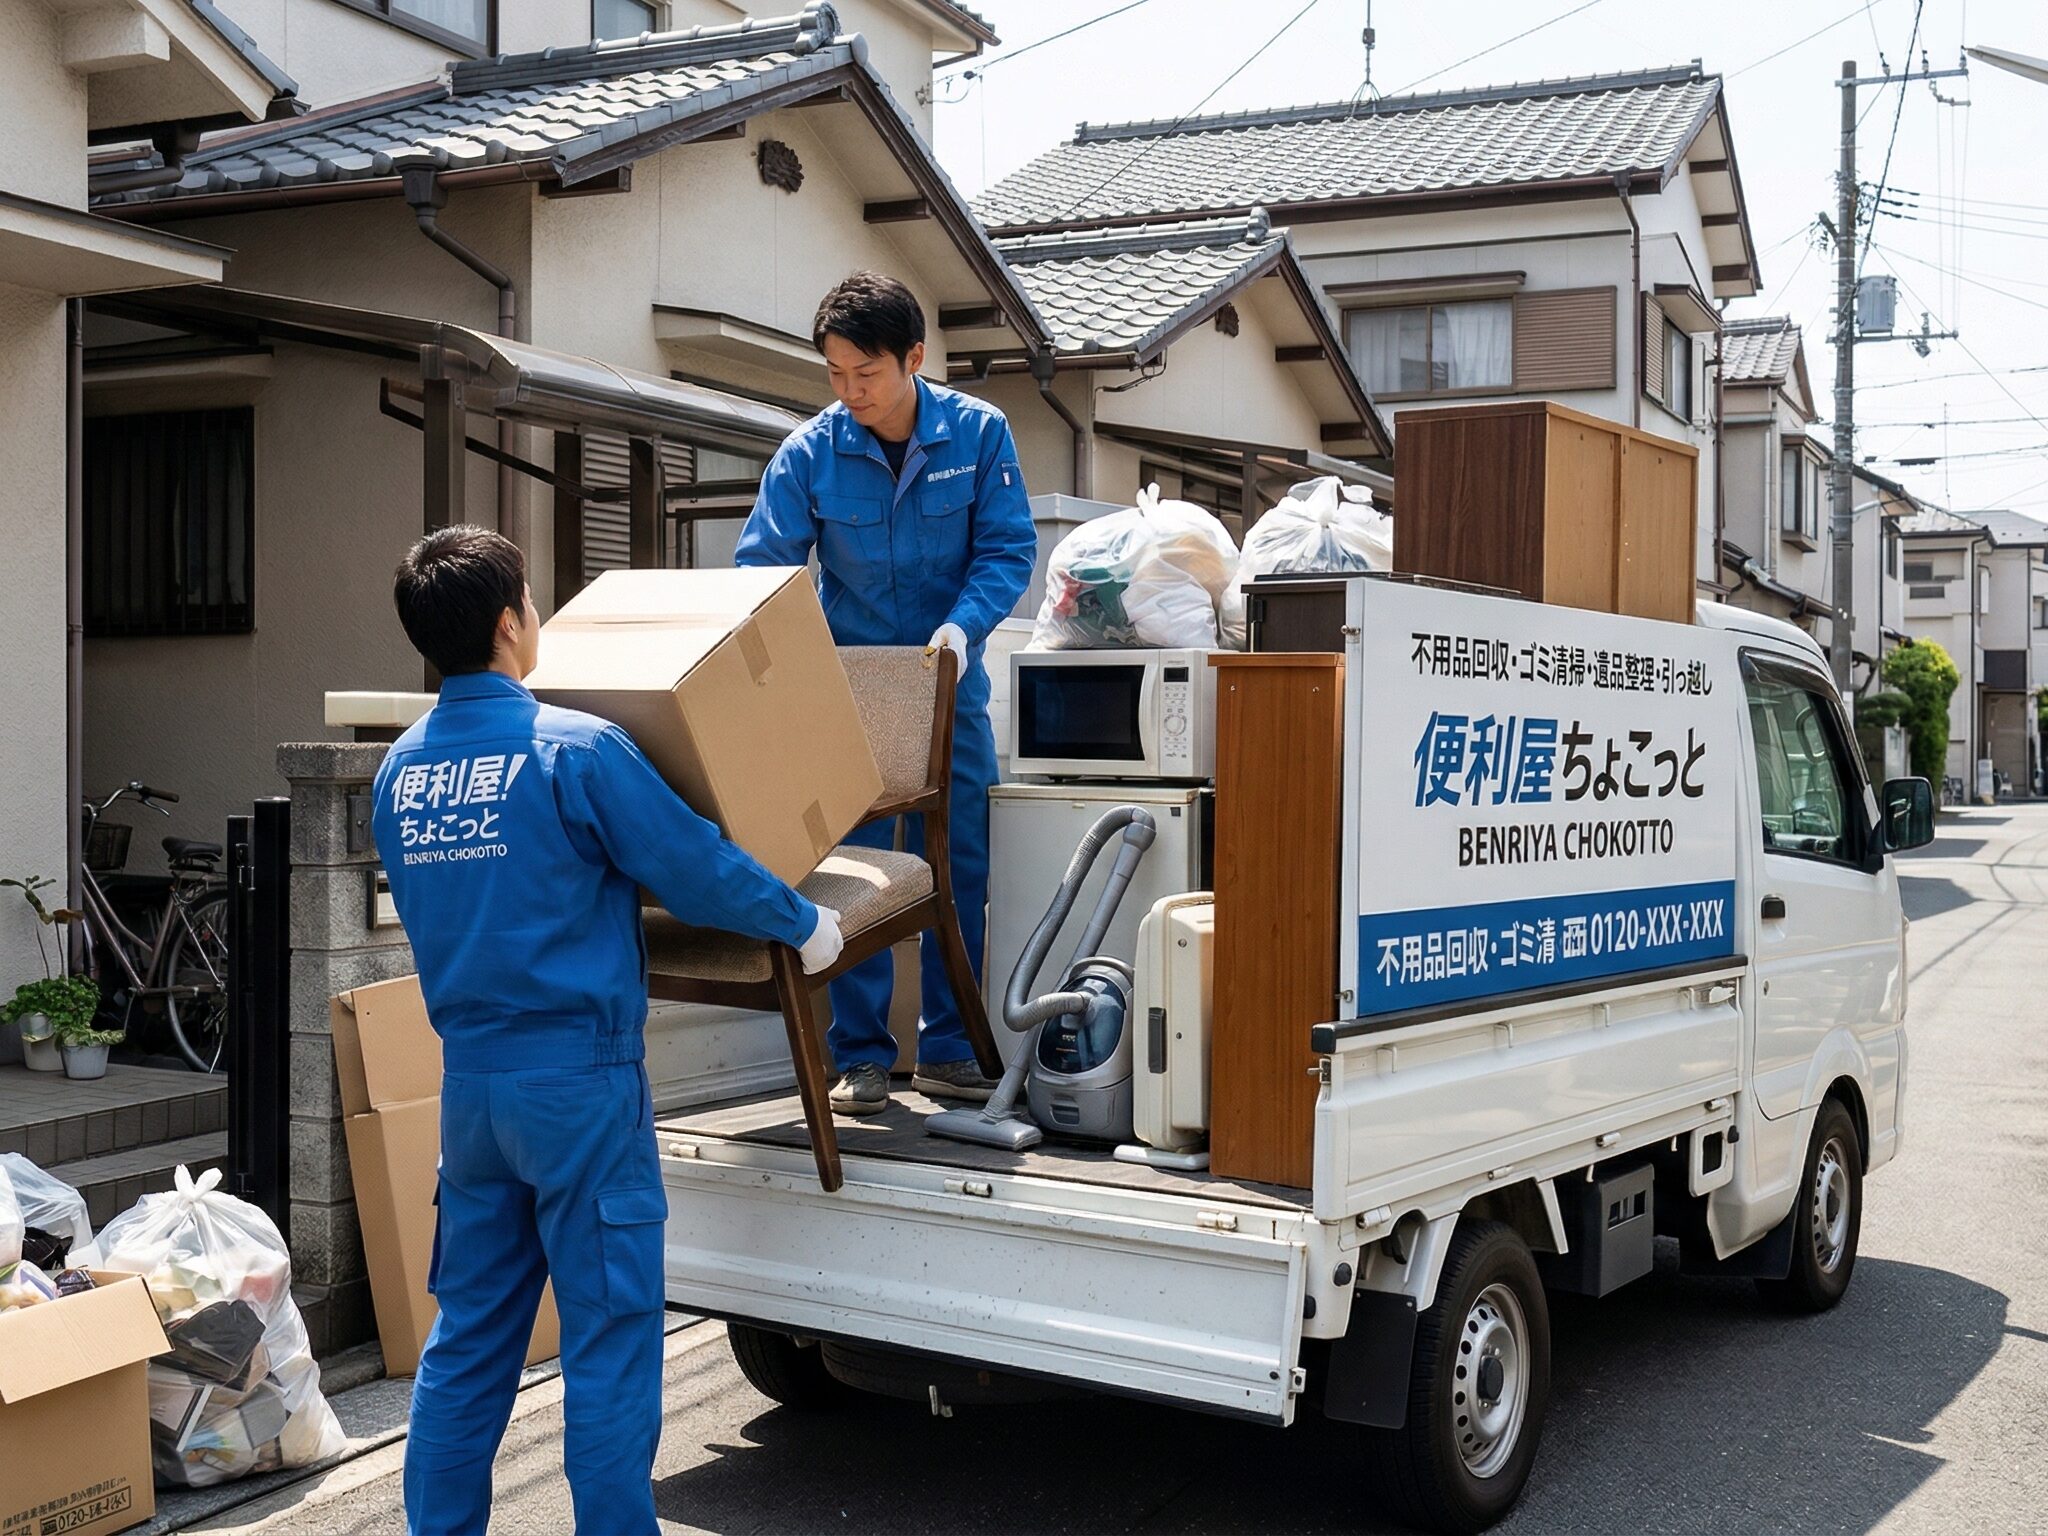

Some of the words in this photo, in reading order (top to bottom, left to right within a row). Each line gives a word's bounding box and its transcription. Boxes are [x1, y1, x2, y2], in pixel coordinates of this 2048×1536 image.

[1413, 711, 1706, 807] 便利屋ちょこっと
[400, 808, 499, 847] ちょこっと
[1459, 823, 1558, 867] BENRIYA
[1564, 819, 1673, 860] CHOKOTTO
[447, 843, 508, 861] CHOKOTTO
[1590, 898, 1724, 956] 0120-XXX-XXX
